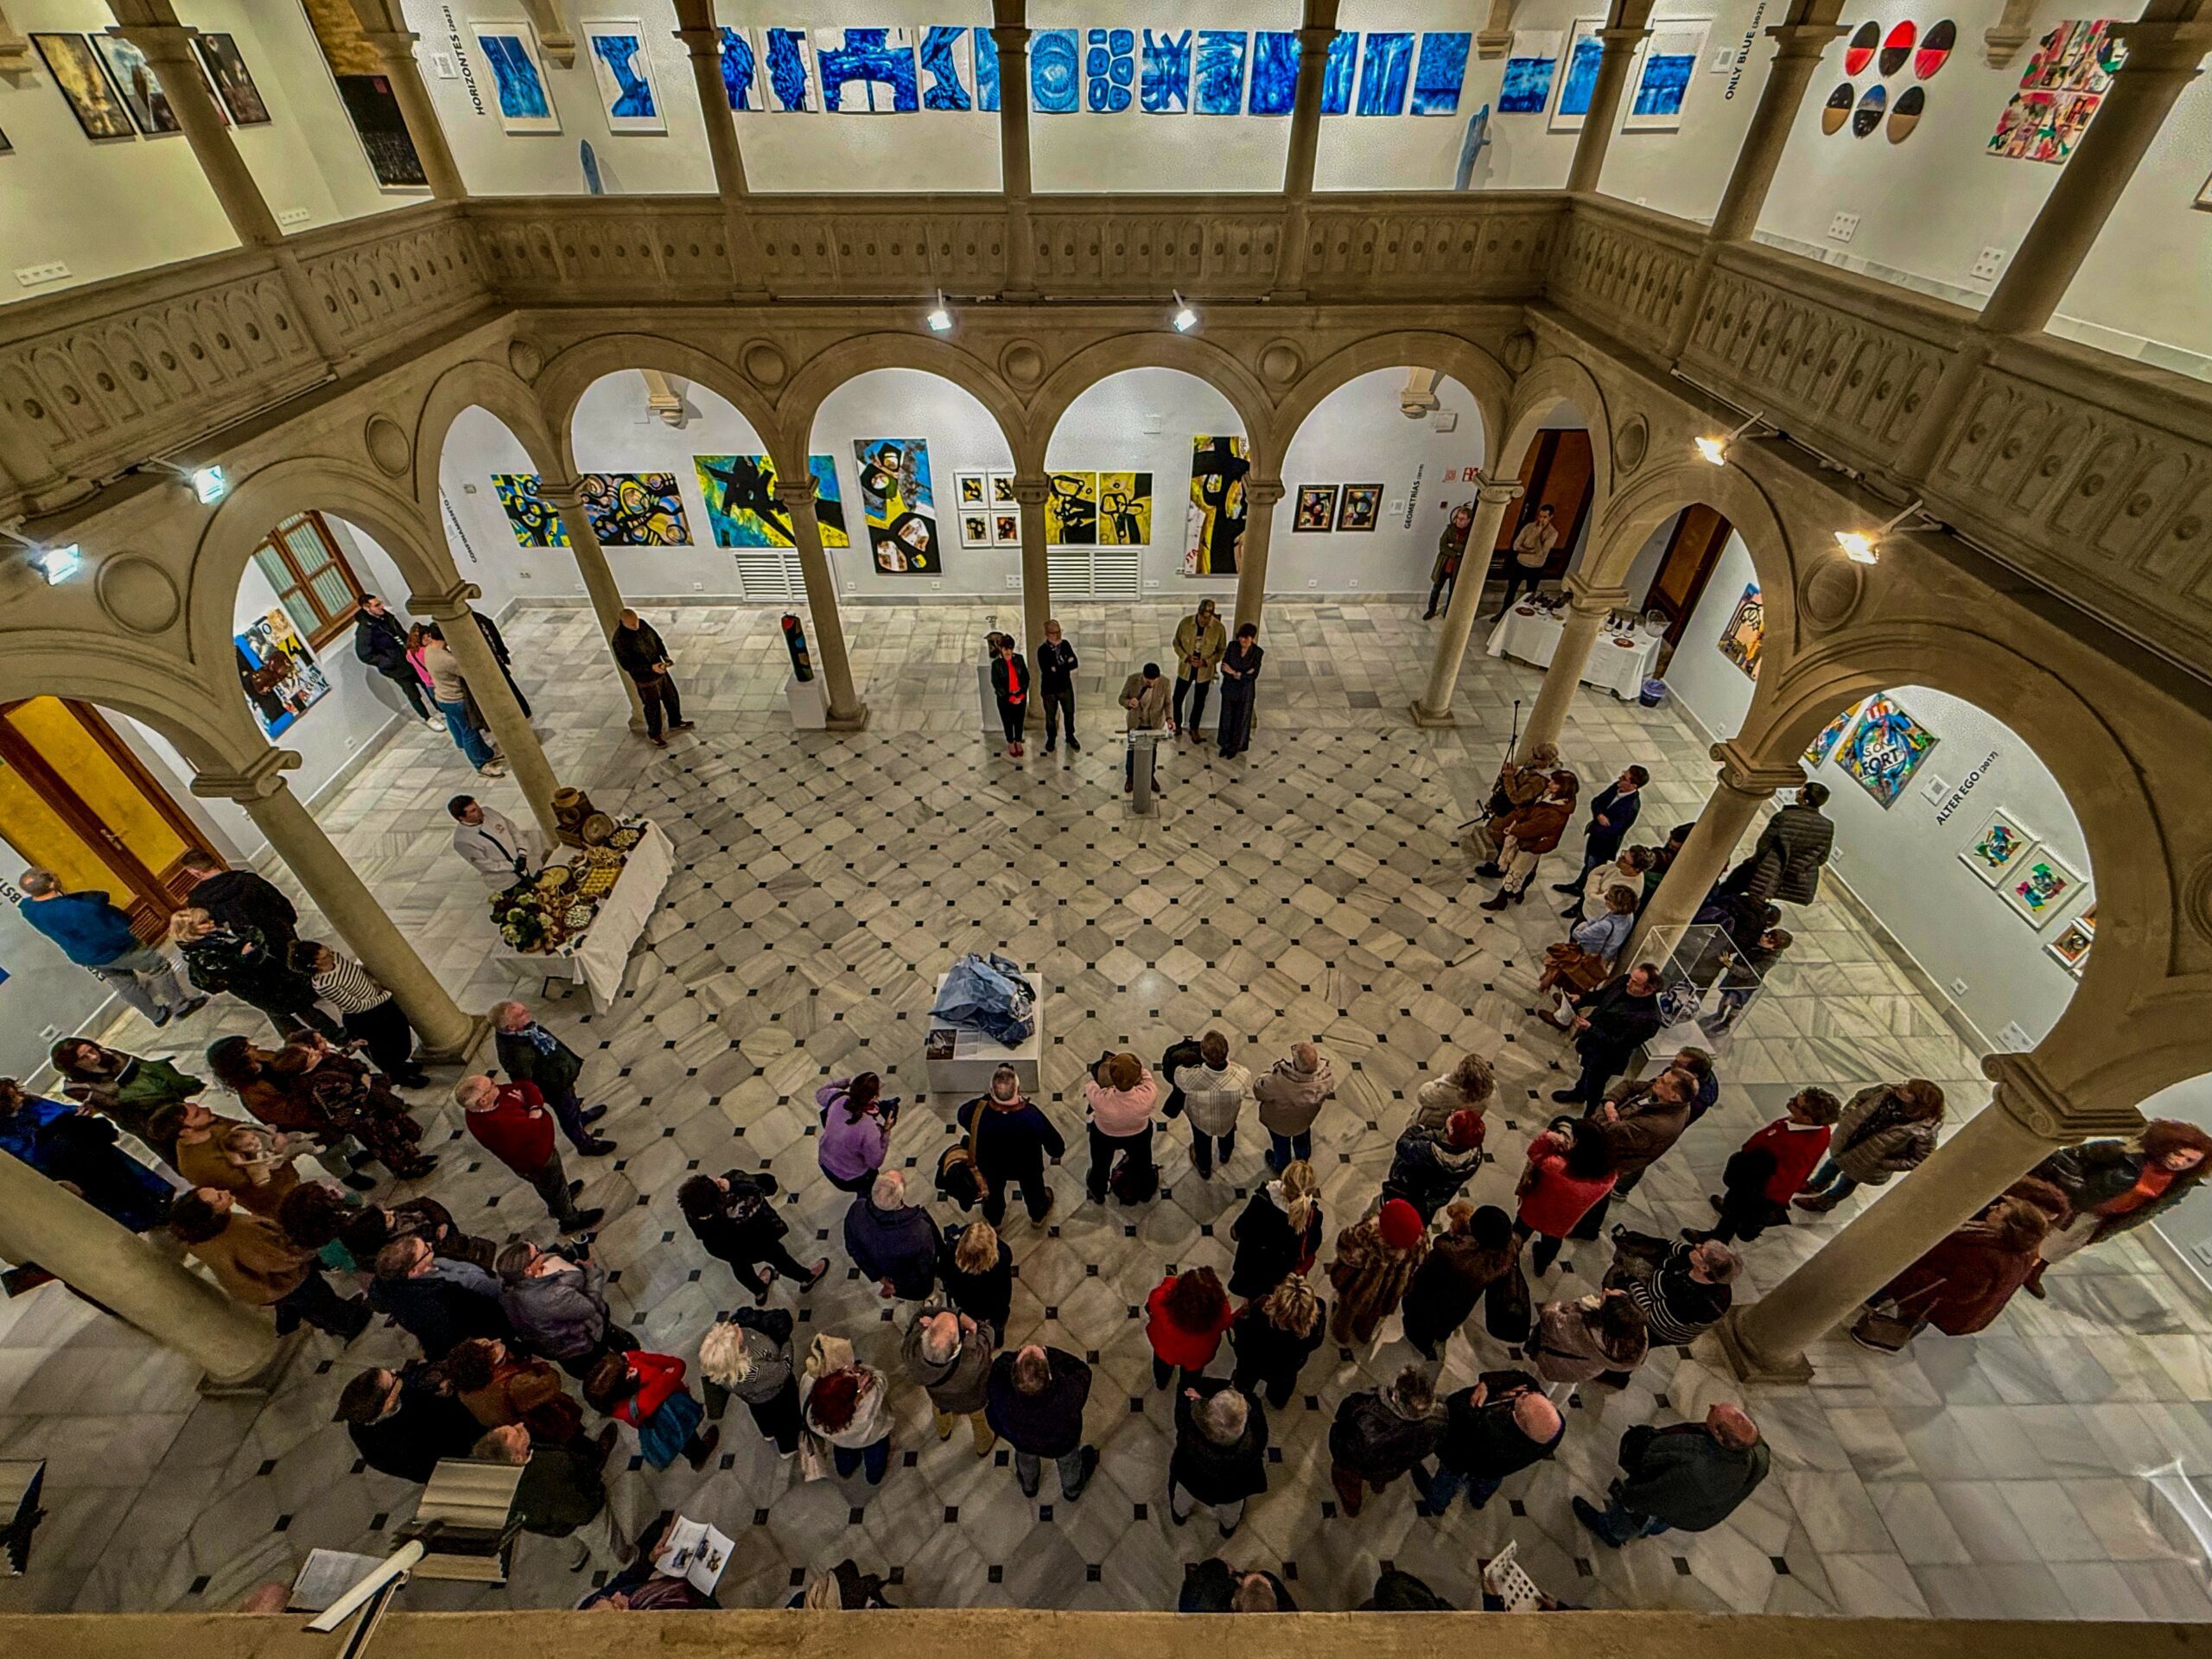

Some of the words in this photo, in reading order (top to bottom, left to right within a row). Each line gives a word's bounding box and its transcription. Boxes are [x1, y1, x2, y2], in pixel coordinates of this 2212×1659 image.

[449, 34, 486, 116] HORIZONTES
[1725, 67, 1742, 100] ONLY
[1737, 31, 1756, 64] BLUE
[443, 499, 478, 564] CONFINAMIENTO
[1403, 480, 1421, 530] GEOMETRÍAS
[1936, 793, 1964, 826] ALTER
[1958, 771, 1980, 796] EGO
[1978, 750, 1999, 774] (2017)
